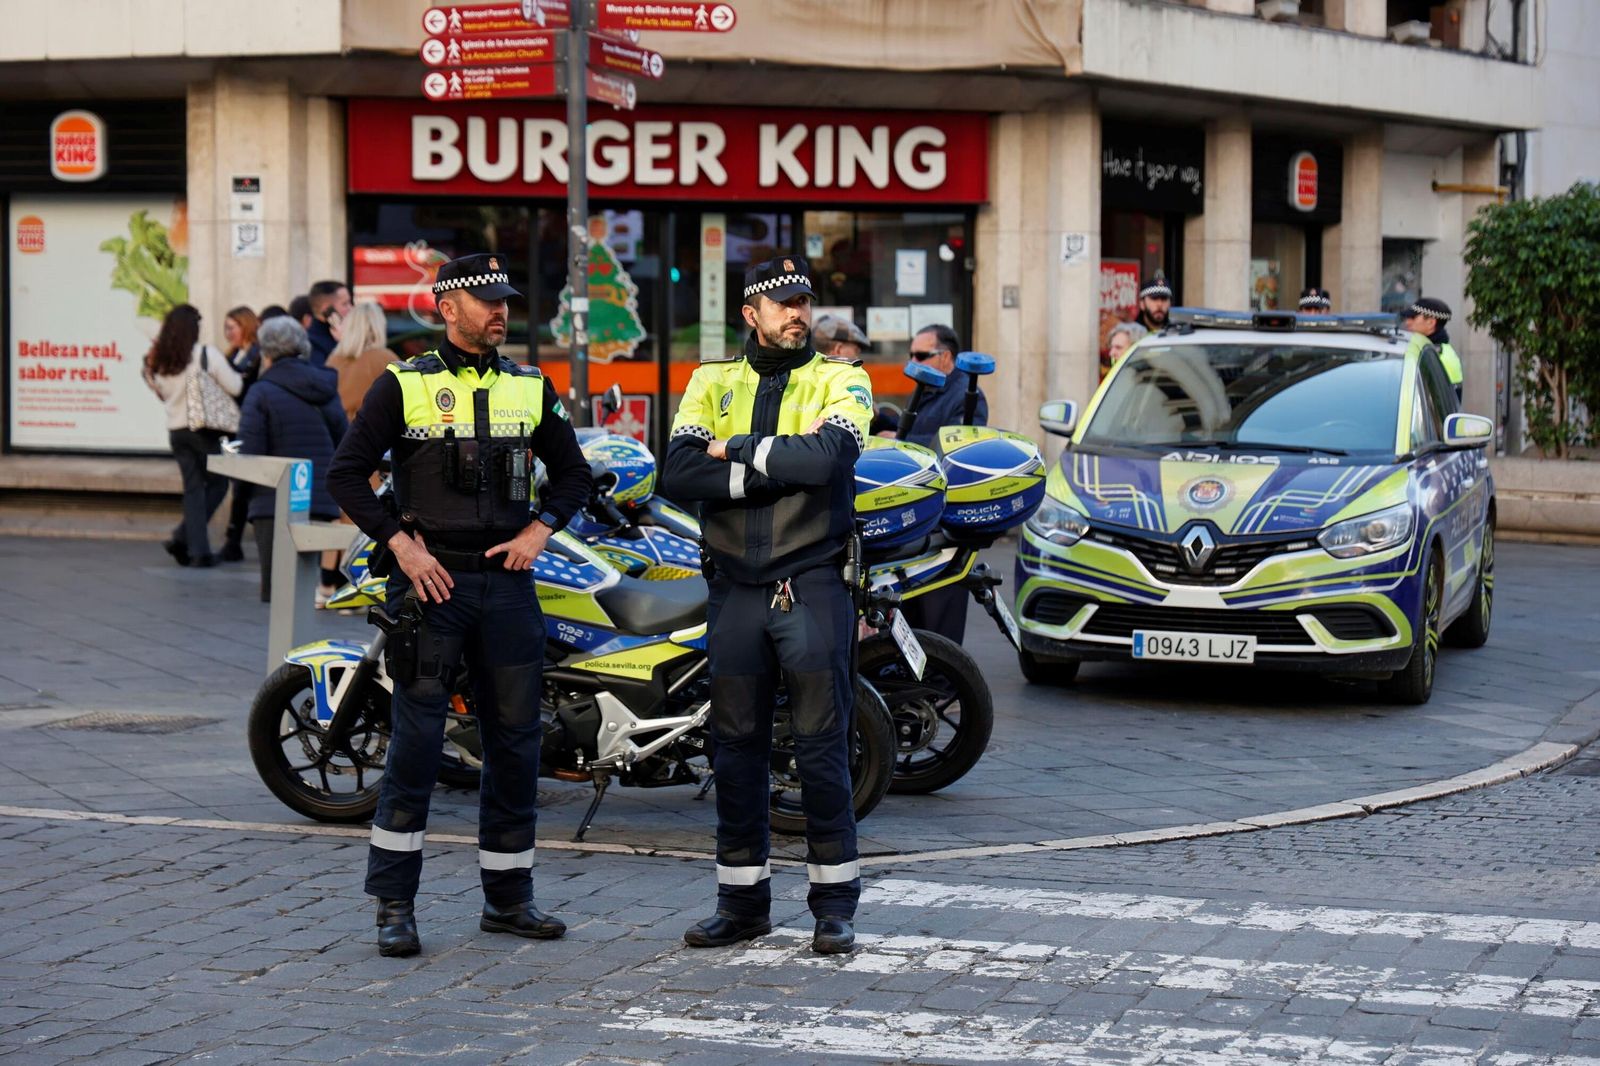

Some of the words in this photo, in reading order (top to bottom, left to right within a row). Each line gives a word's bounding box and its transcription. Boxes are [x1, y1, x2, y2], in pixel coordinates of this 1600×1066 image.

[634, 5, 644, 14] de
[660, 18, 692, 27] Museum
[461, 40, 485, 50] Iglesia
[486, 39, 495, 47] de
[517, 49, 544, 58] Church
[56, 135, 96, 146] BURGER
[56, 149, 96, 163] KING
[411, 115, 728, 187] BURGER
[758, 123, 947, 190] KING
[1103, 149, 1132, 177] Have
[1146, 162, 1178, 191] your
[18, 340, 79, 358] Belleza
[82, 341, 122, 361] real,
[18, 363, 66, 380] sabor
[70, 364, 109, 381] real.
[964, 513, 1000, 523] LOCAL
[557, 623, 584, 638] 092
[559, 632, 577, 644] 112
[1147, 636, 1200, 657] 0943
[1208, 639, 1249, 659] LJZ
[584, 660, 652, 671] policia.sevilla.org
